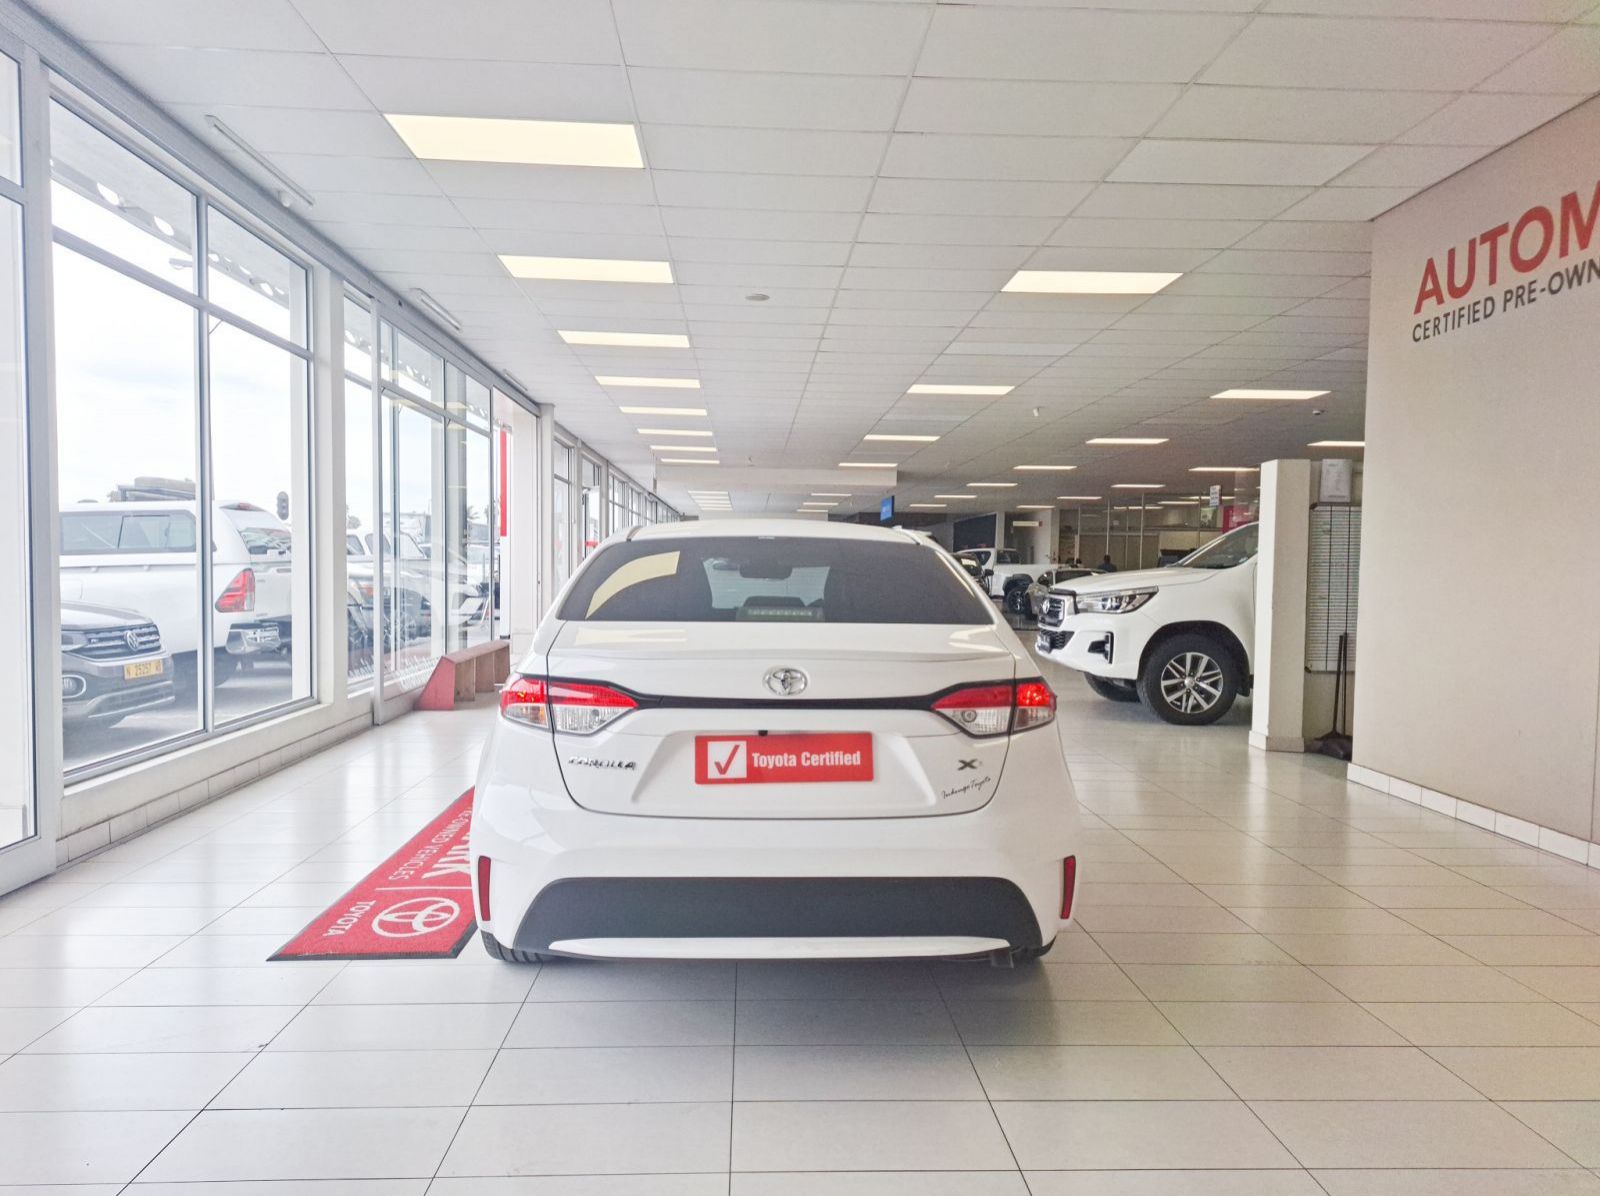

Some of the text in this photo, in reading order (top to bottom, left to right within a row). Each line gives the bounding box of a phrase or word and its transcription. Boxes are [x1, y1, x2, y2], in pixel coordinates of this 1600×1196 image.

[1413, 179, 1600, 315] AUTOM
[1412, 256, 1600, 342] CERTIFIED PRE-OWN
[752, 750, 861, 769] Toyota Certified
[388, 843, 443, 880] VEHICLES
[322, 900, 377, 937] TOYOTA
